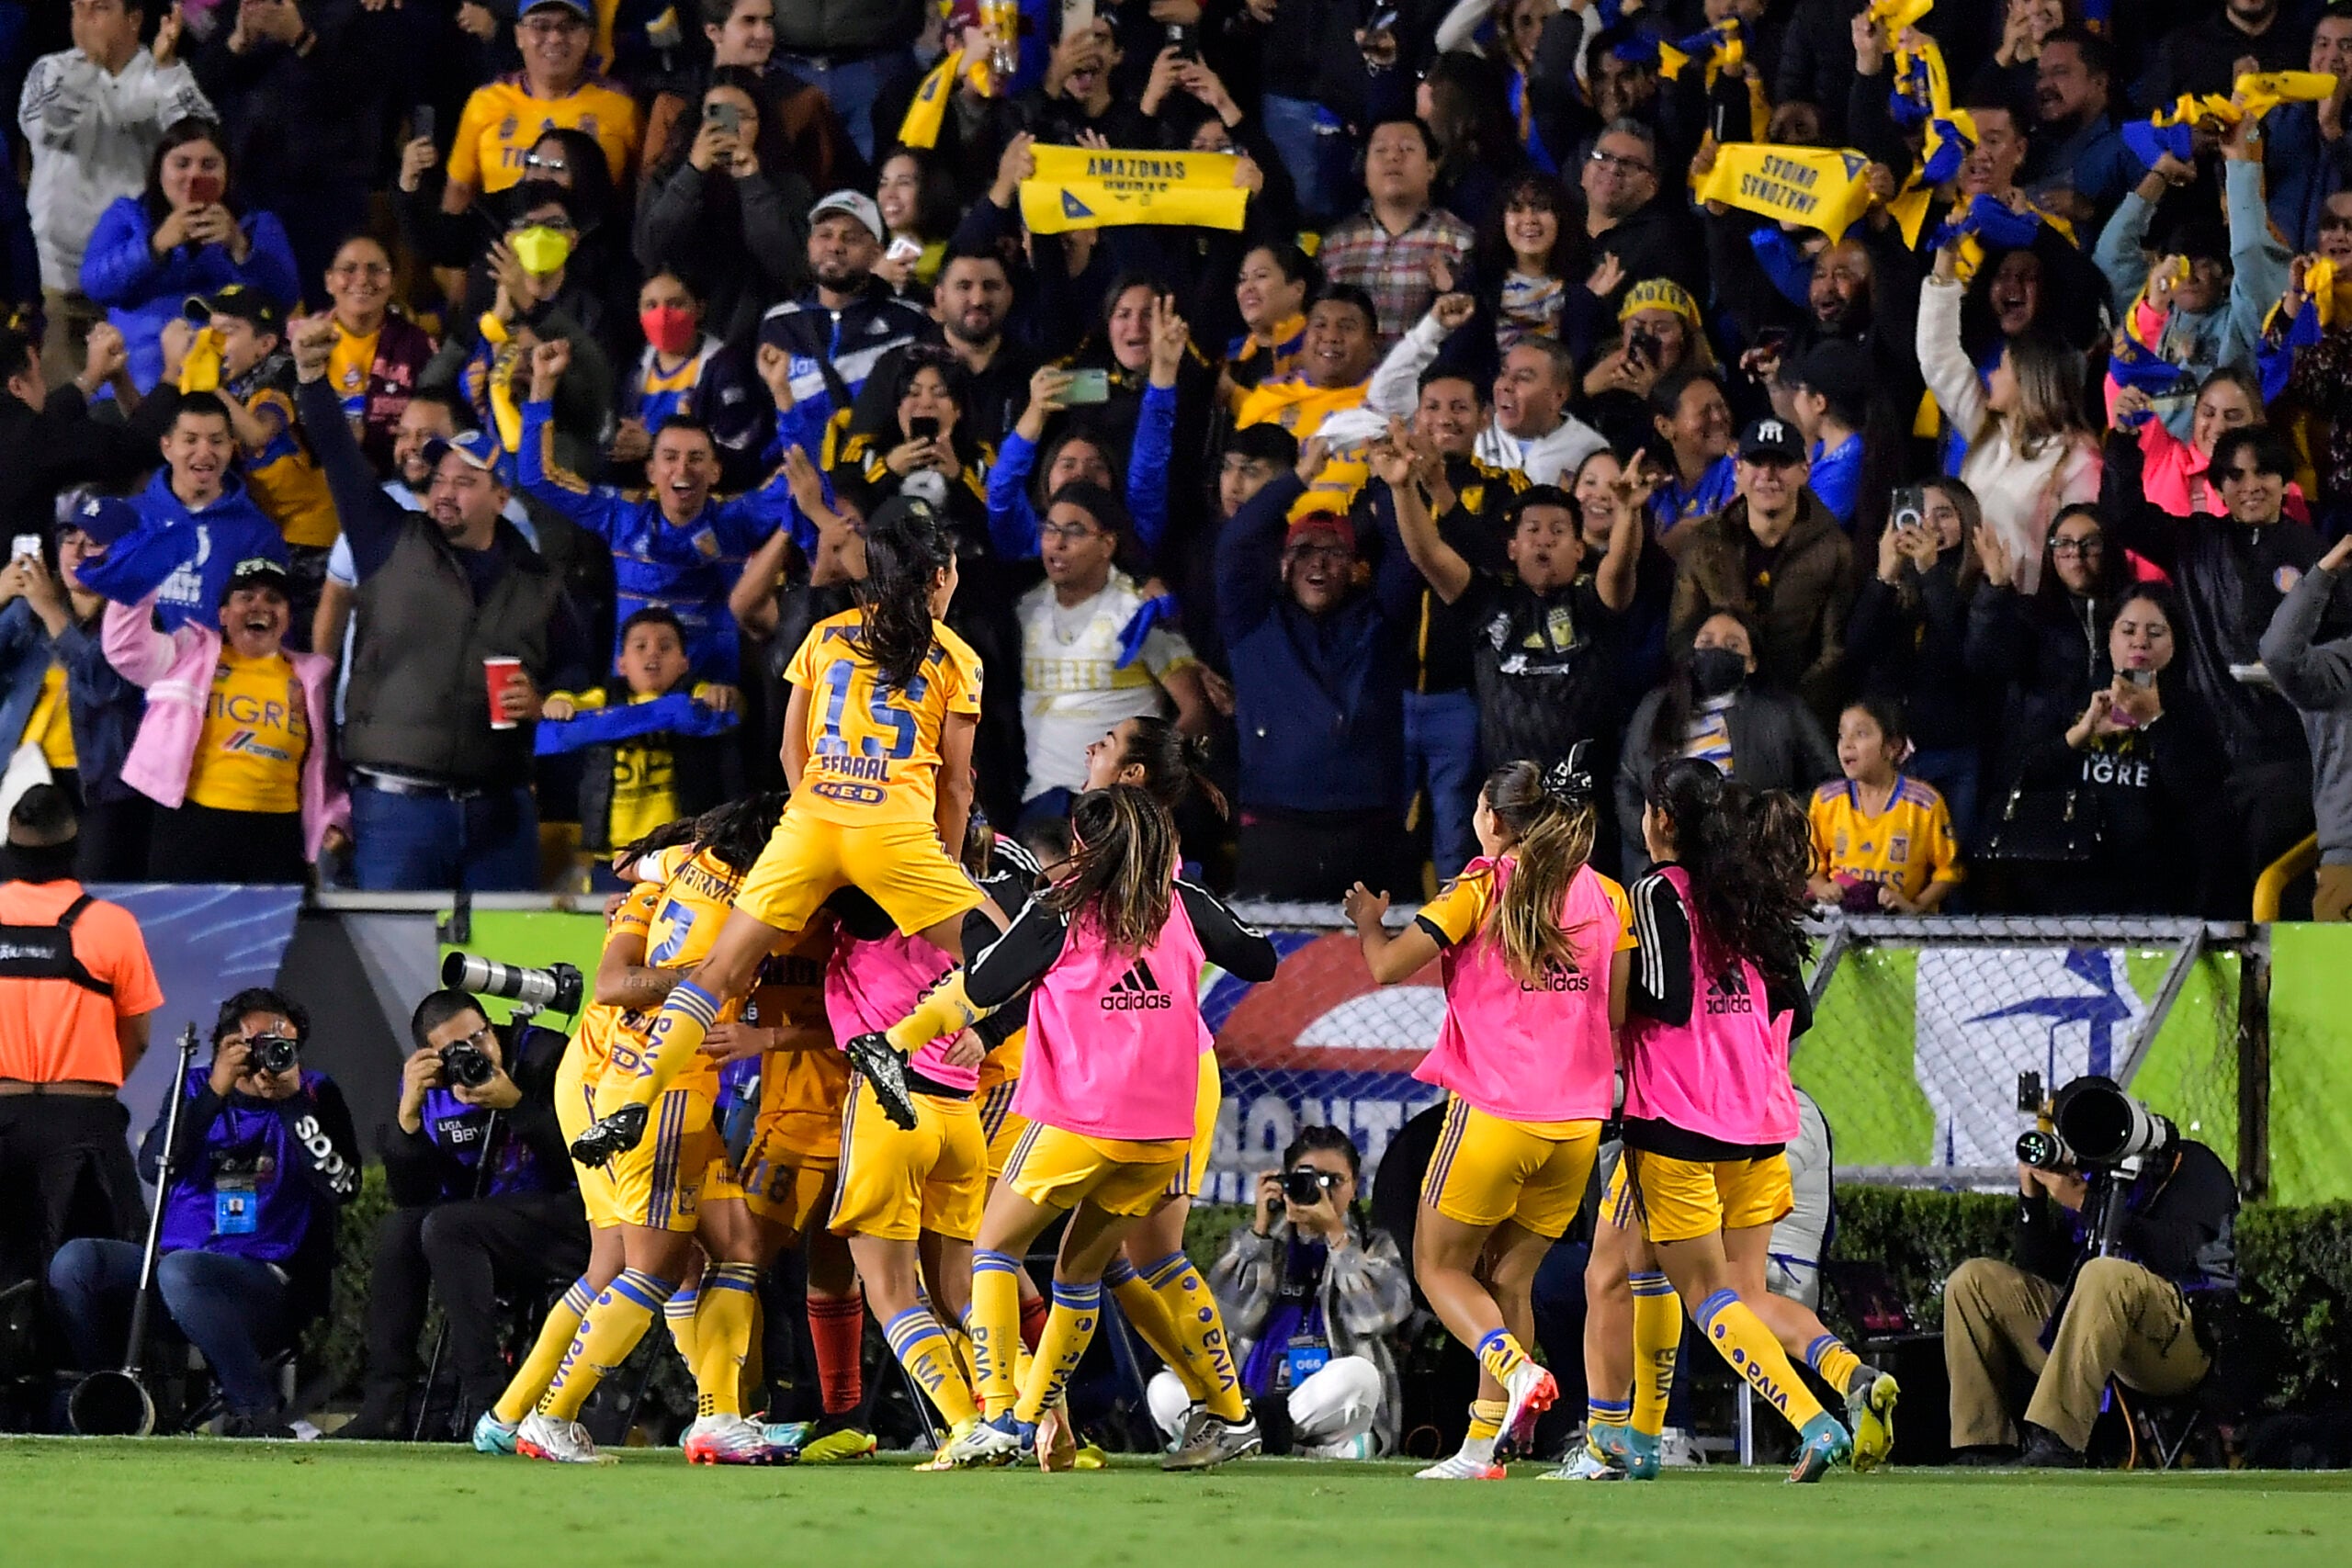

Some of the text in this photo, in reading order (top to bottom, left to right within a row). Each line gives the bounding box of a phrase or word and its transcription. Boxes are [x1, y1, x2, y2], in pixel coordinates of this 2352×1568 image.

[1088, 158, 1185, 179] AMAZONAS
[815, 659, 928, 760] 15
[1101, 991, 1172, 1011] adidas
[438, 1121, 462, 1132] LIGA
[972, 1326, 992, 1382] viva
[1202, 1327, 1235, 1393] viva
[1746, 1359, 1788, 1413] viva
